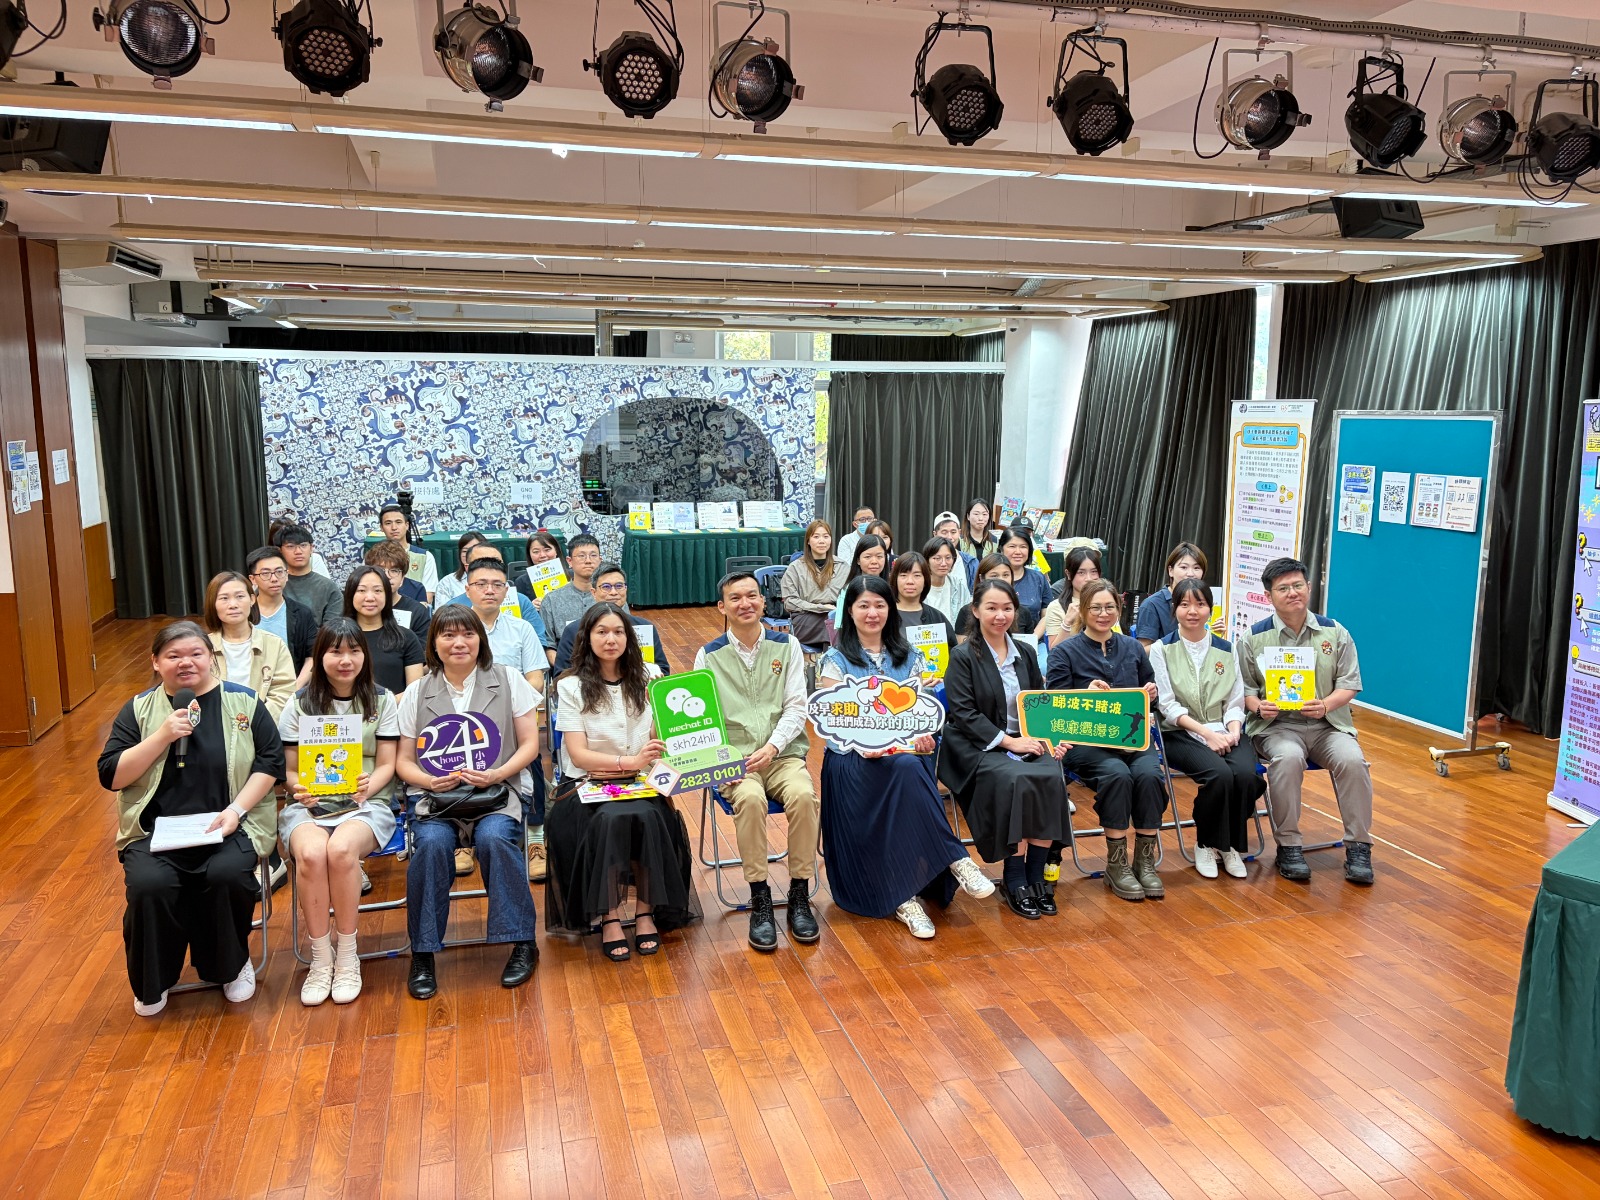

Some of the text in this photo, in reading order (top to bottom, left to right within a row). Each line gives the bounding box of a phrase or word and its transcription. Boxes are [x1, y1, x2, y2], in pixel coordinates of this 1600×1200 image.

[162, 303, 168, 311] 6
[414, 486, 440, 496] 接待處
[1052, 695, 1122, 715] 睇波不賭波
[668, 717, 713, 733] wechat ID
[827, 715, 939, 732] 讓我們成為你的助力
[1050, 718, 1121, 739] 健康選擇多
[419, 712, 490, 771] 24
[673, 732, 716, 751] skh24hli
[440, 755, 465, 764] hours
[475, 751, 486, 770] 小時
[680, 772, 711, 789] 2823
[713, 765, 742, 781] 0101
